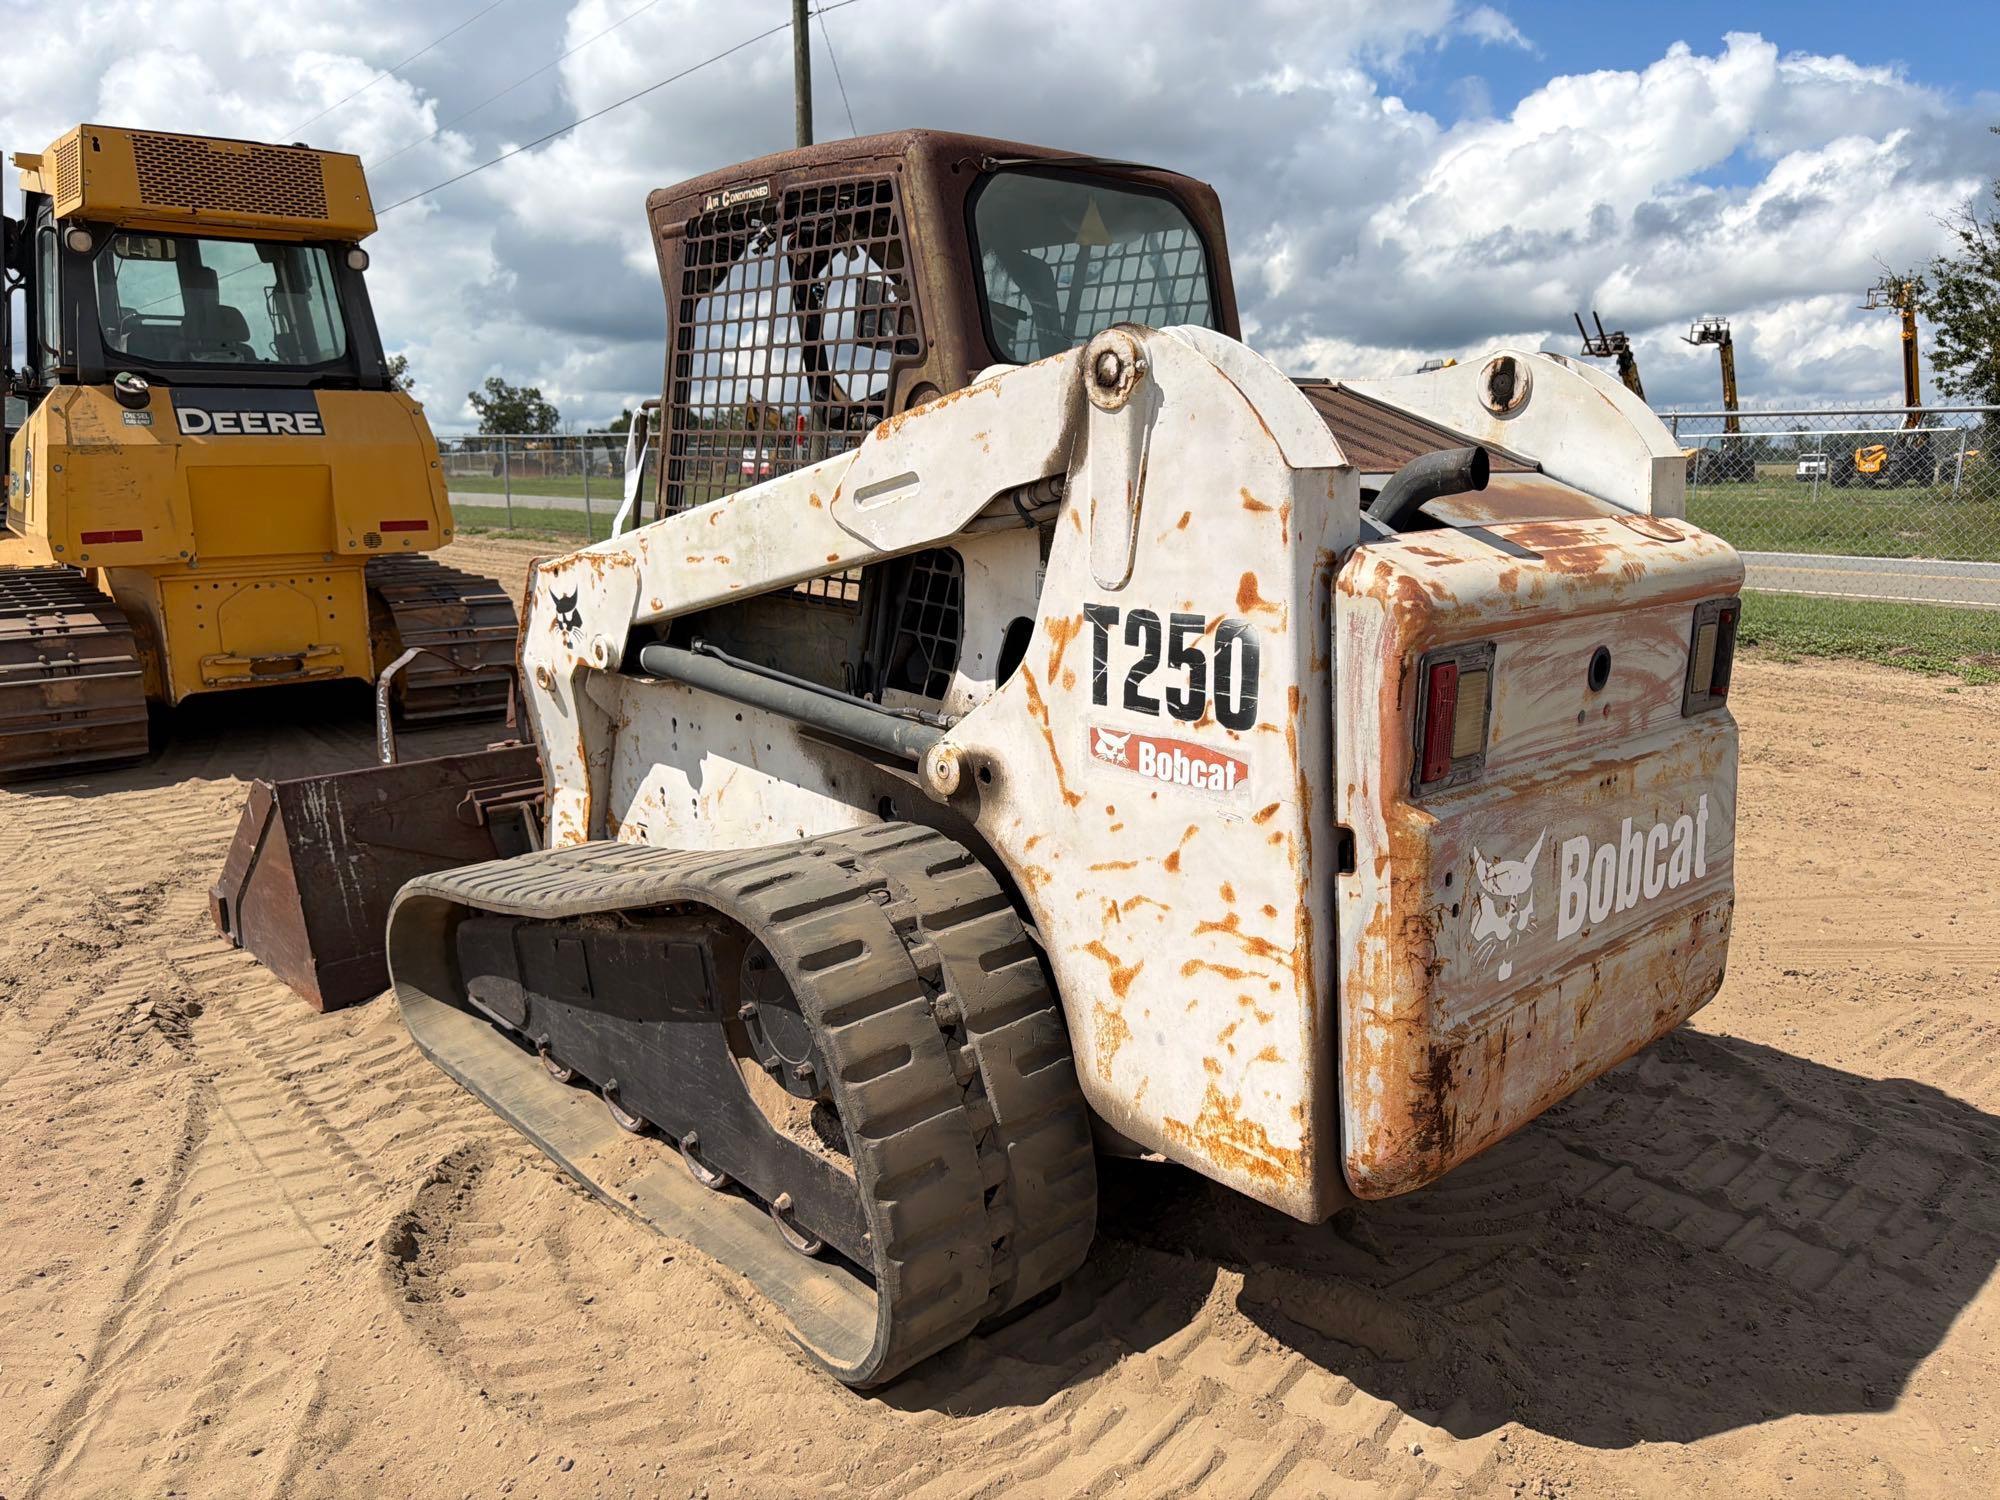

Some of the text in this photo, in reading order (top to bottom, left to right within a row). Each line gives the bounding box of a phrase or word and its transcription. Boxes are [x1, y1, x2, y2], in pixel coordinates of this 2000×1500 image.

[176, 407, 323, 434] DEERE
[1083, 602, 1261, 731] T250
[1138, 741, 1236, 791] Bobcat
[1557, 793, 1709, 941] Bobcat
